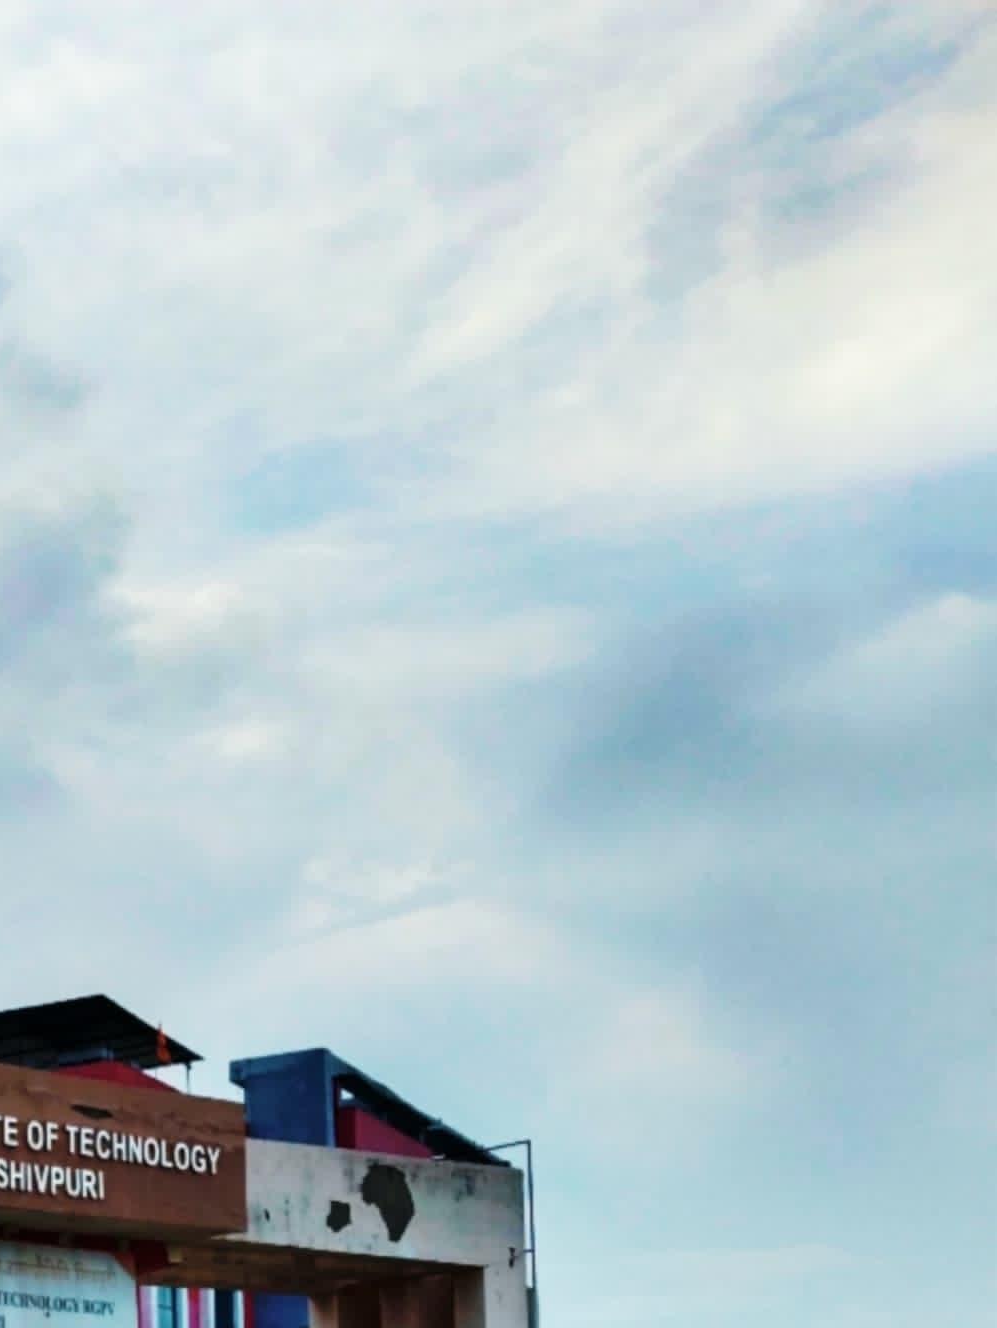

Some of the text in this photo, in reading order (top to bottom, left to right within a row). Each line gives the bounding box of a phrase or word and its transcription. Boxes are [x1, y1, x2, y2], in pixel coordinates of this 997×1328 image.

[26, 1120, 59, 1152] OF
[66, 1125, 222, 1176] TECHNOLOGY
[82, 1298, 115, 1316] RGPV
